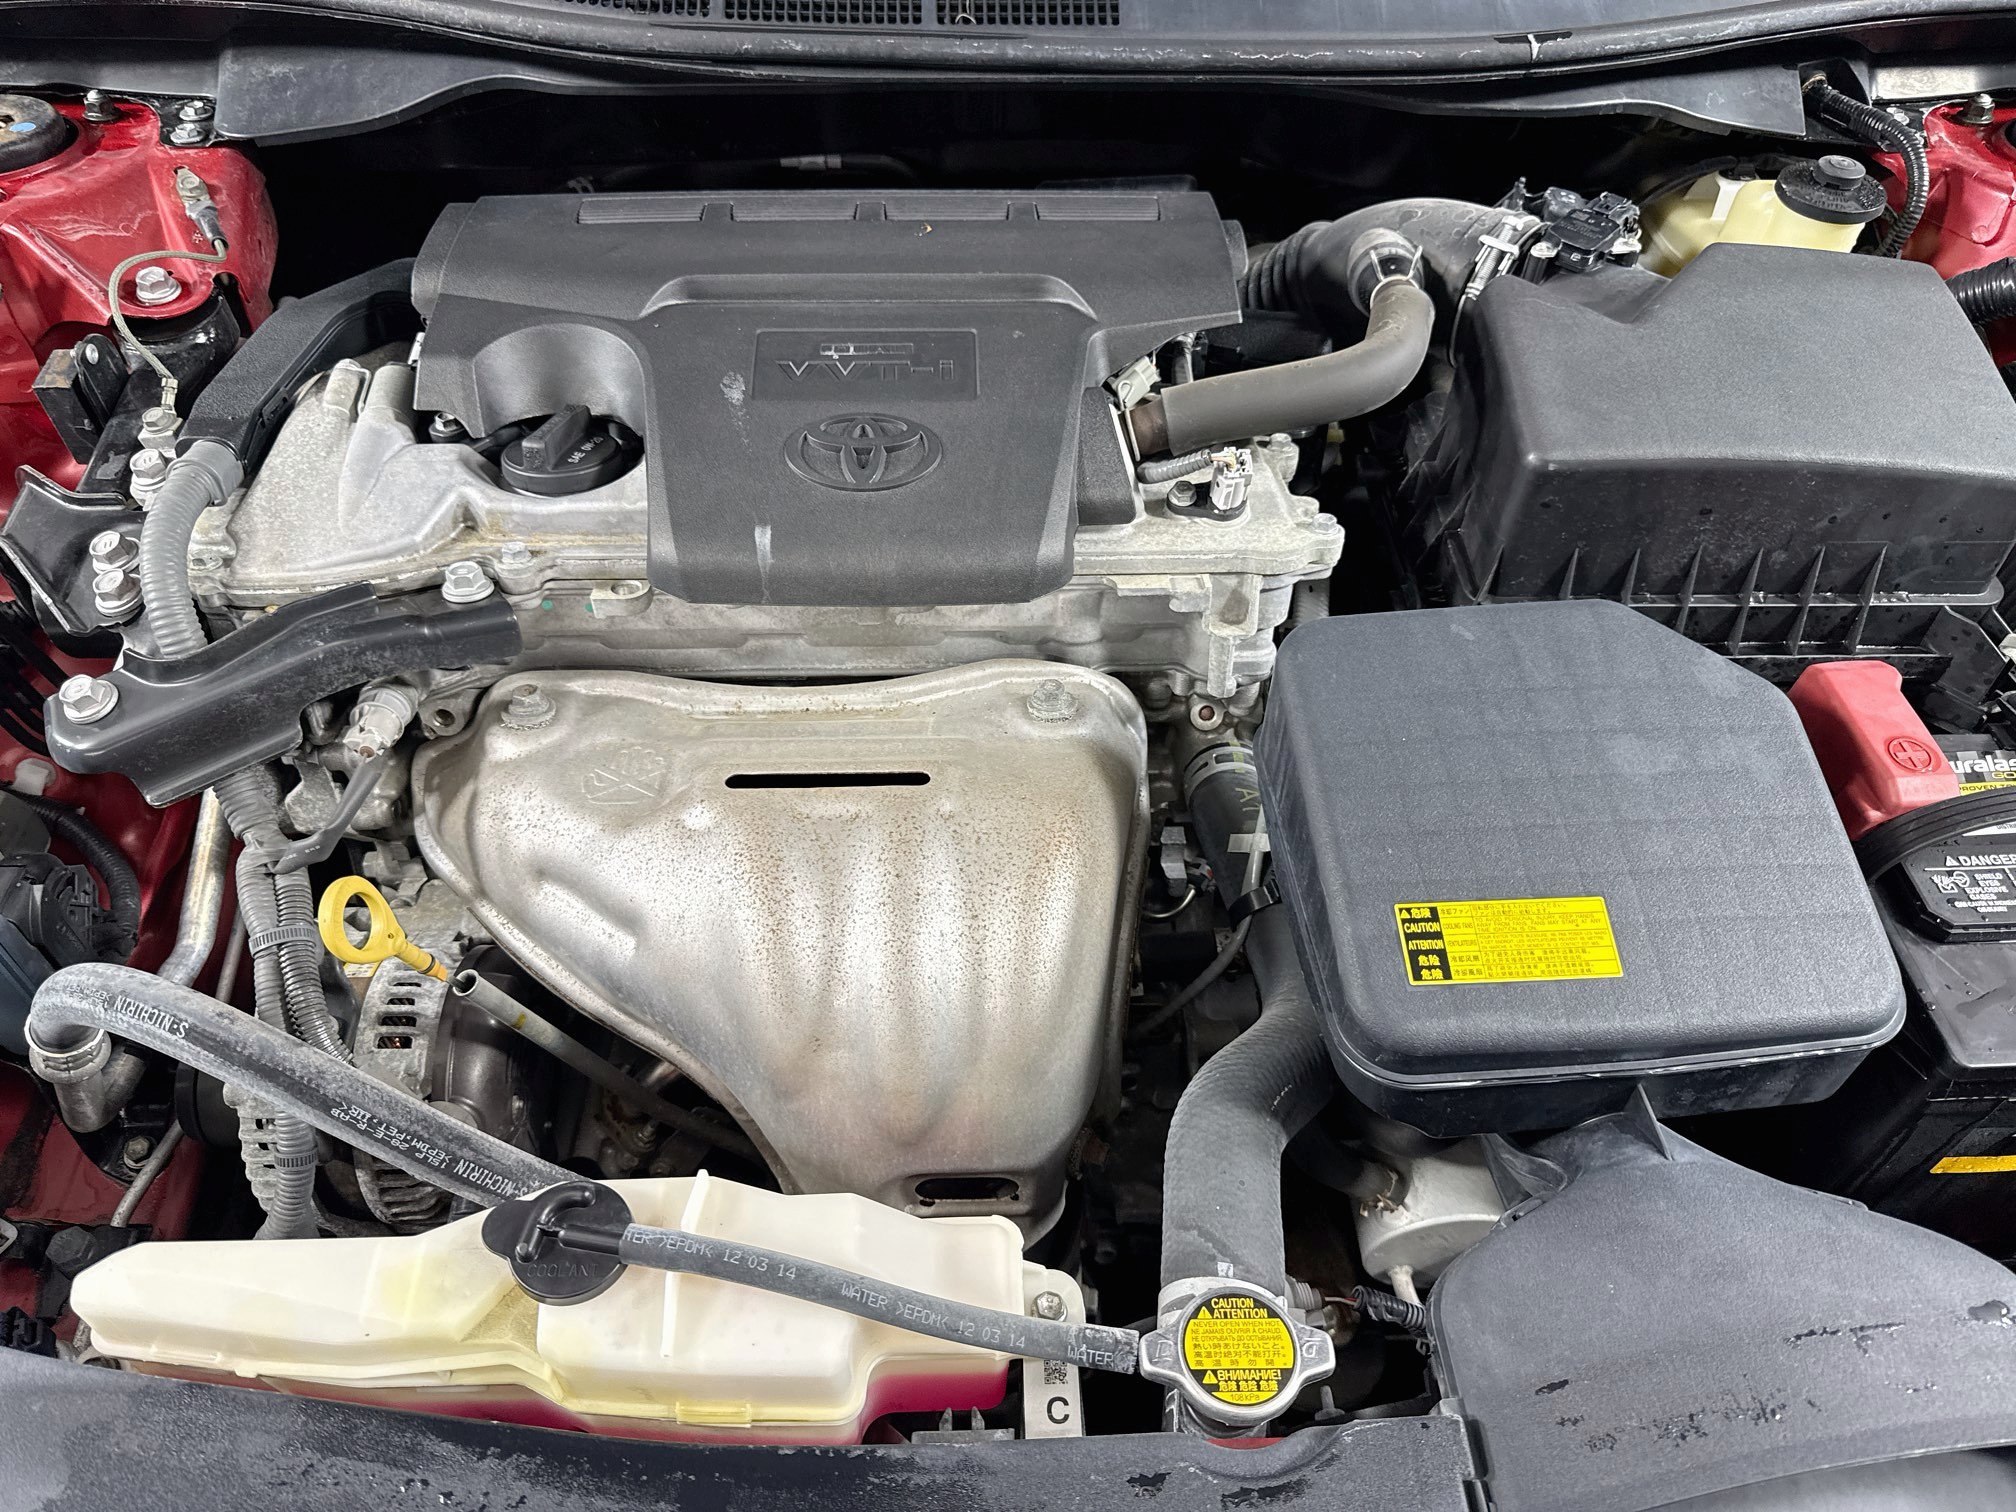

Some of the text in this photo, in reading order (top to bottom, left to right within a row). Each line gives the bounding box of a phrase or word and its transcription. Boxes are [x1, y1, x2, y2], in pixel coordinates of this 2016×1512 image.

[775, 360, 954, 382] VVT-i
[567, 451, 586, 464] SAE
[1973, 873, 2003, 881] SHIELD
[1964, 886, 2009, 894] EXPLOSIVE
[1968, 893, 1998, 901] GASES
[1404, 922, 1441, 933] CAUTION
[1408, 939, 1445, 950] ATTENTION
[527, 1263, 599, 1277] COOLANT
[723, 1249, 743, 1265] 12
[747, 1255, 769, 1272] 03
[778, 1263, 797, 1280] 14
[1211, 1297, 1254, 1309] CAUTION
[841, 1281, 888, 1311] WATER
[958, 1320, 975, 1338] 12
[982, 1327, 1001, 1344] 03
[1009, 1333, 1026, 1349] 14
[1213, 1308, 1268, 1319] ATTENTION
[1219, 1320, 1240, 1328] OPEN
[1241, 1320, 1264, 1328] WHEN
[1067, 1345, 1114, 1368] WATER
[1217, 1369, 1282, 1380] ВНИМАНИЕ!
[1046, 1395, 1070, 1425] C
